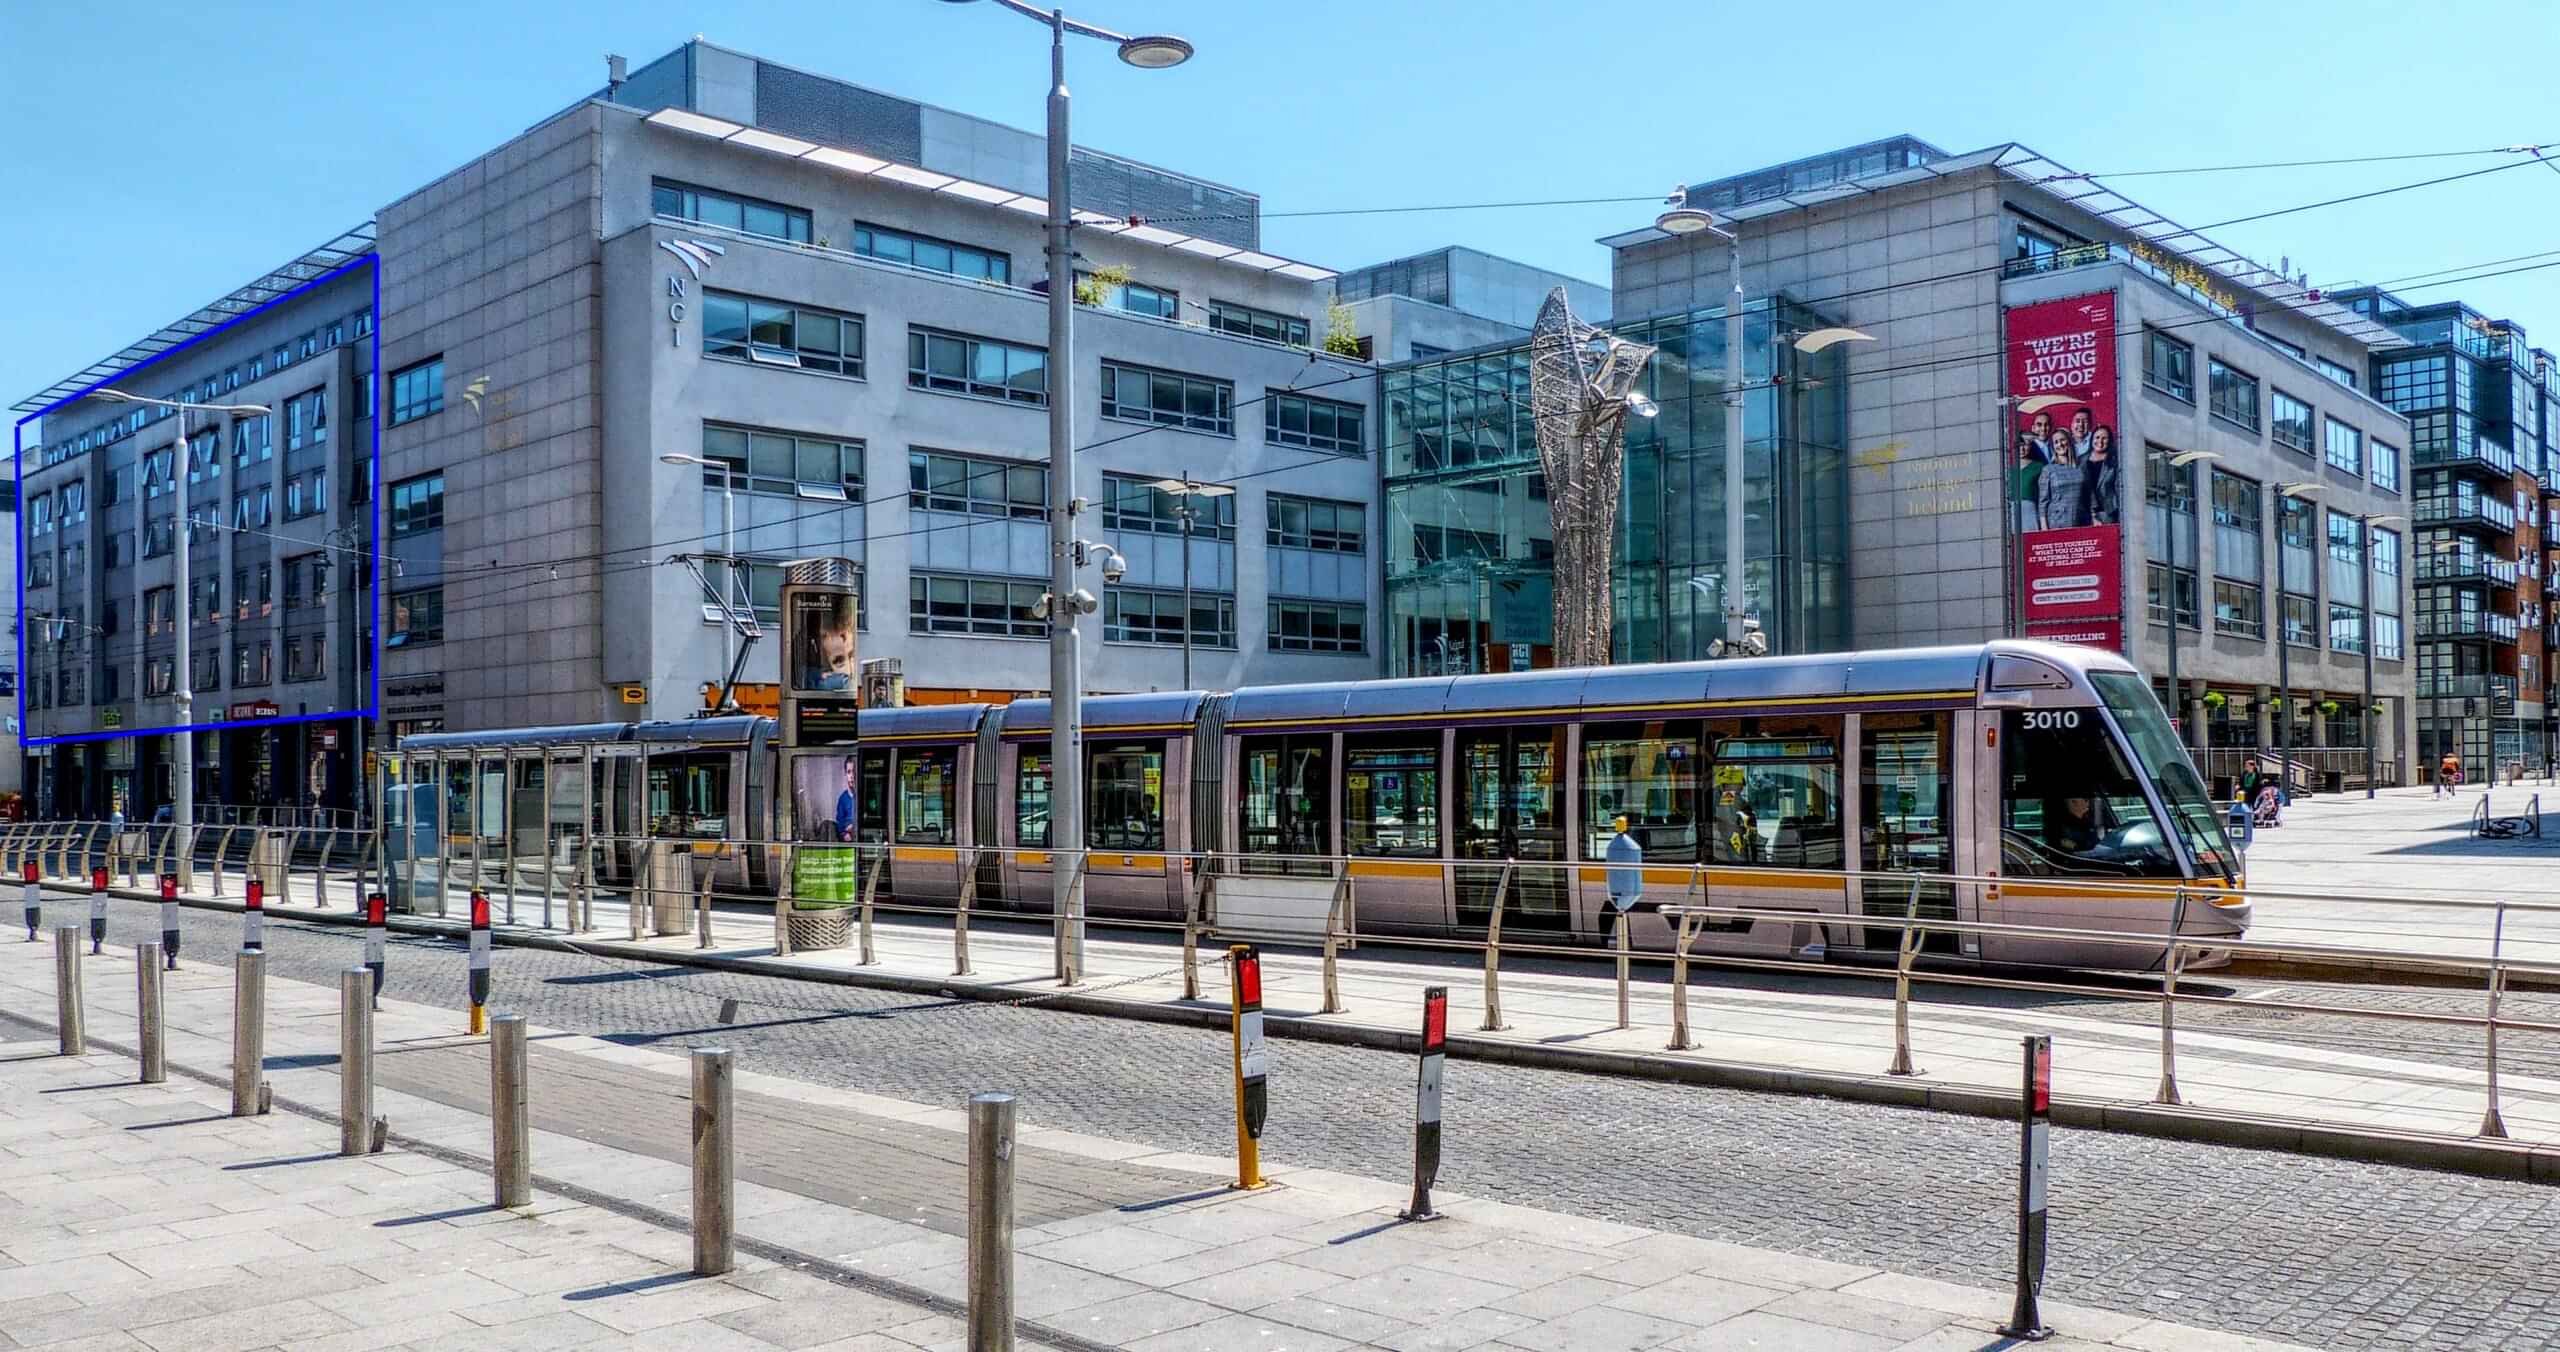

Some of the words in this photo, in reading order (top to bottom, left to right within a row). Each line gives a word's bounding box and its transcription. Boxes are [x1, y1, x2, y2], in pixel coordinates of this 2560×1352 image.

[668, 276, 687, 347] NCI
[2024, 349, 2096, 375] LIVING
[2027, 367, 2096, 392] PROOF
[2022, 710, 2080, 729] 3010
